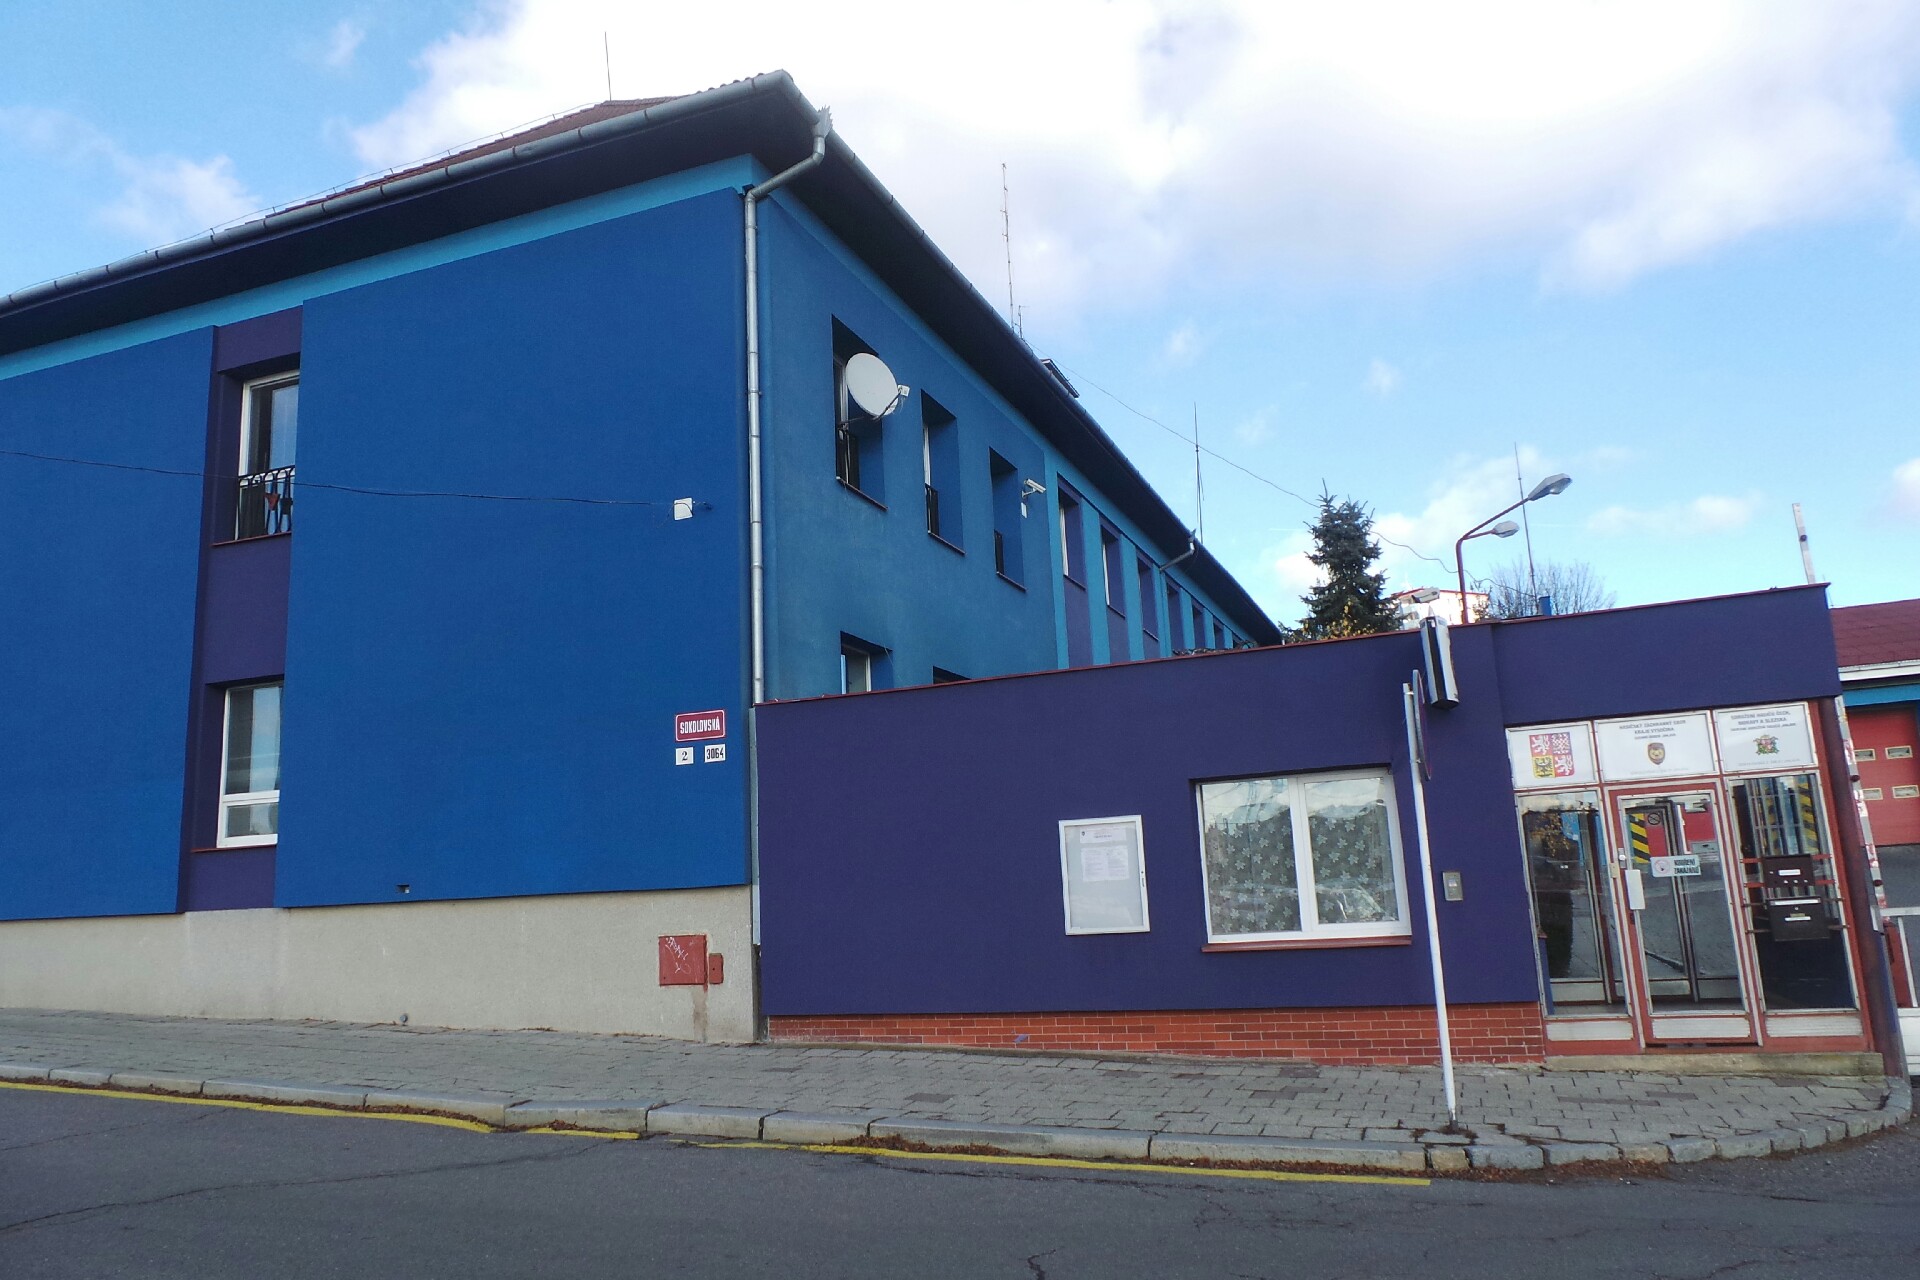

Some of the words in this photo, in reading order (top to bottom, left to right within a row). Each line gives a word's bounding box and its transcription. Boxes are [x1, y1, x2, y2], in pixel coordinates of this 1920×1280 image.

[680, 715, 721, 734] SOKOLOVSKÁ
[681, 750, 688, 761] 2
[706, 748, 724, 760] 3064
